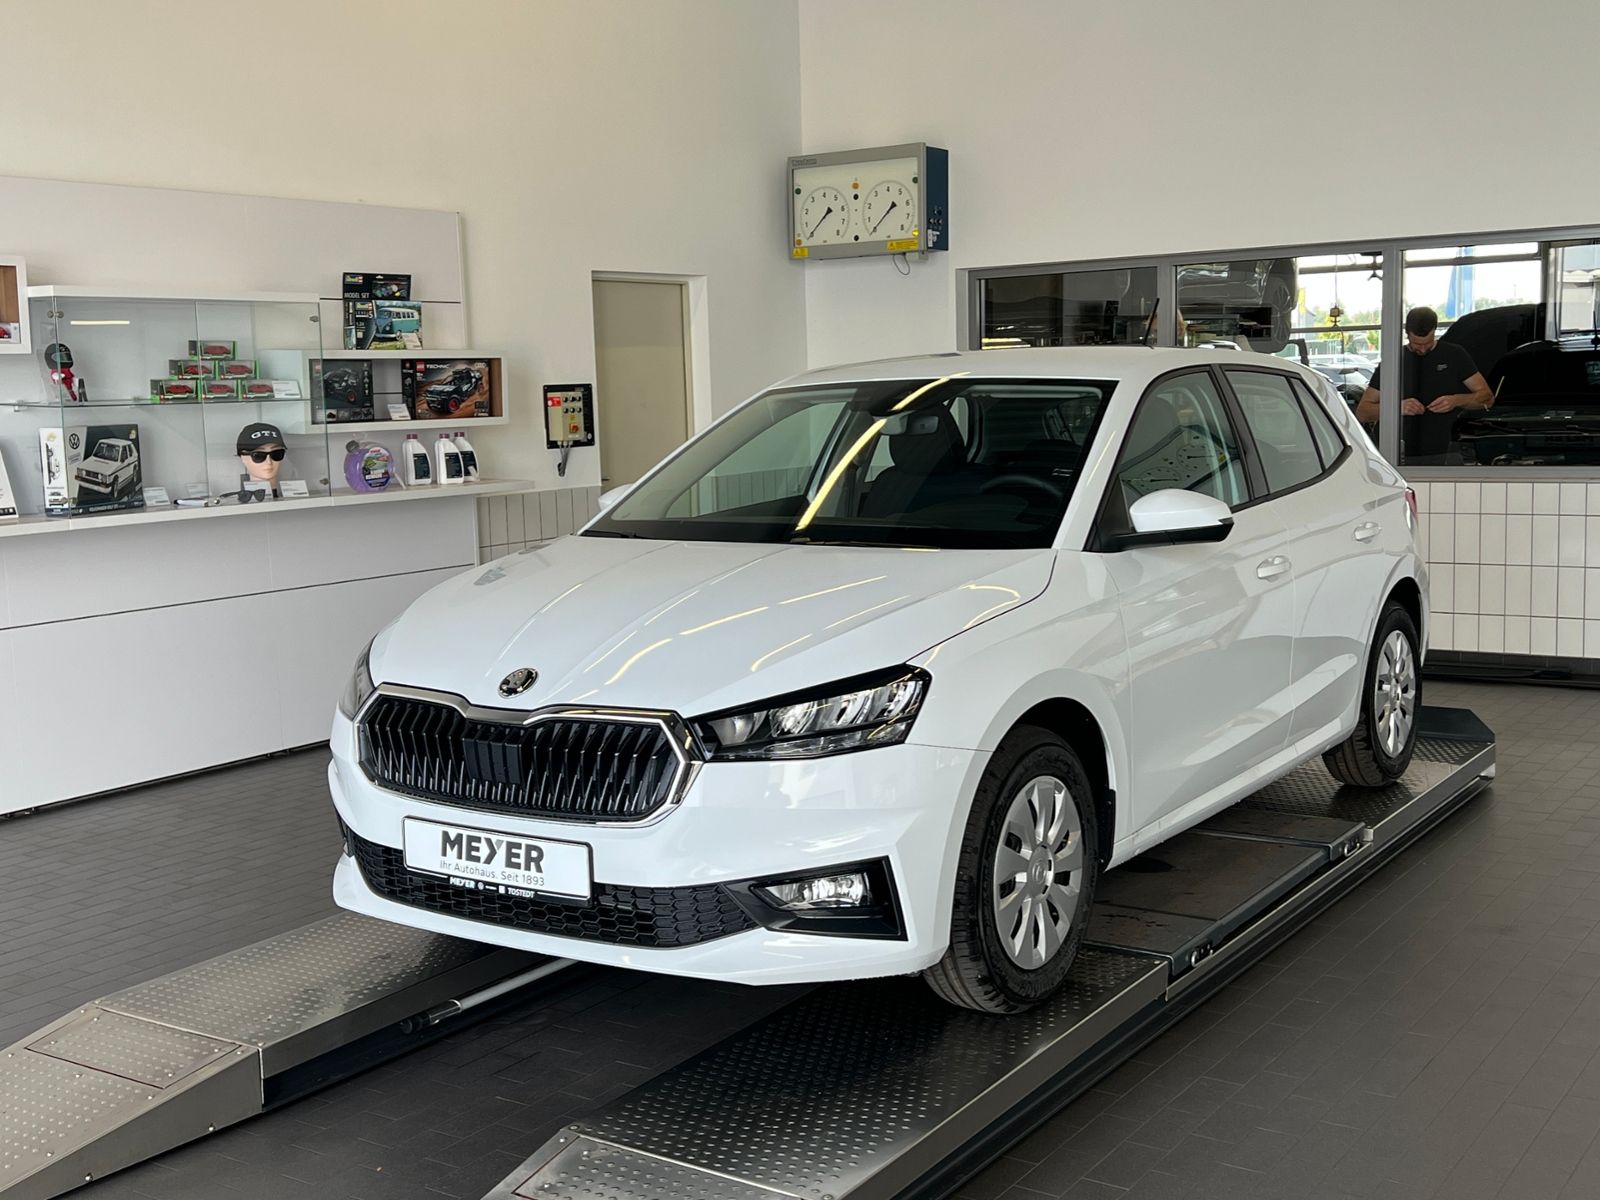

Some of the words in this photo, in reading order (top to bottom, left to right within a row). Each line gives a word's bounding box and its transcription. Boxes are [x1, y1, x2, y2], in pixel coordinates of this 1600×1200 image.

[251, 430, 277, 439] GTI
[440, 830, 545, 873] MEYER
[440, 860, 452, 870] Ihr
[454, 863, 498, 879] Autohaus.
[501, 870, 519, 883] Seit
[522, 874, 545, 887] 1893
[449, 876, 476, 889] MEYER
[507, 887, 536, 898] TOSTEDT
